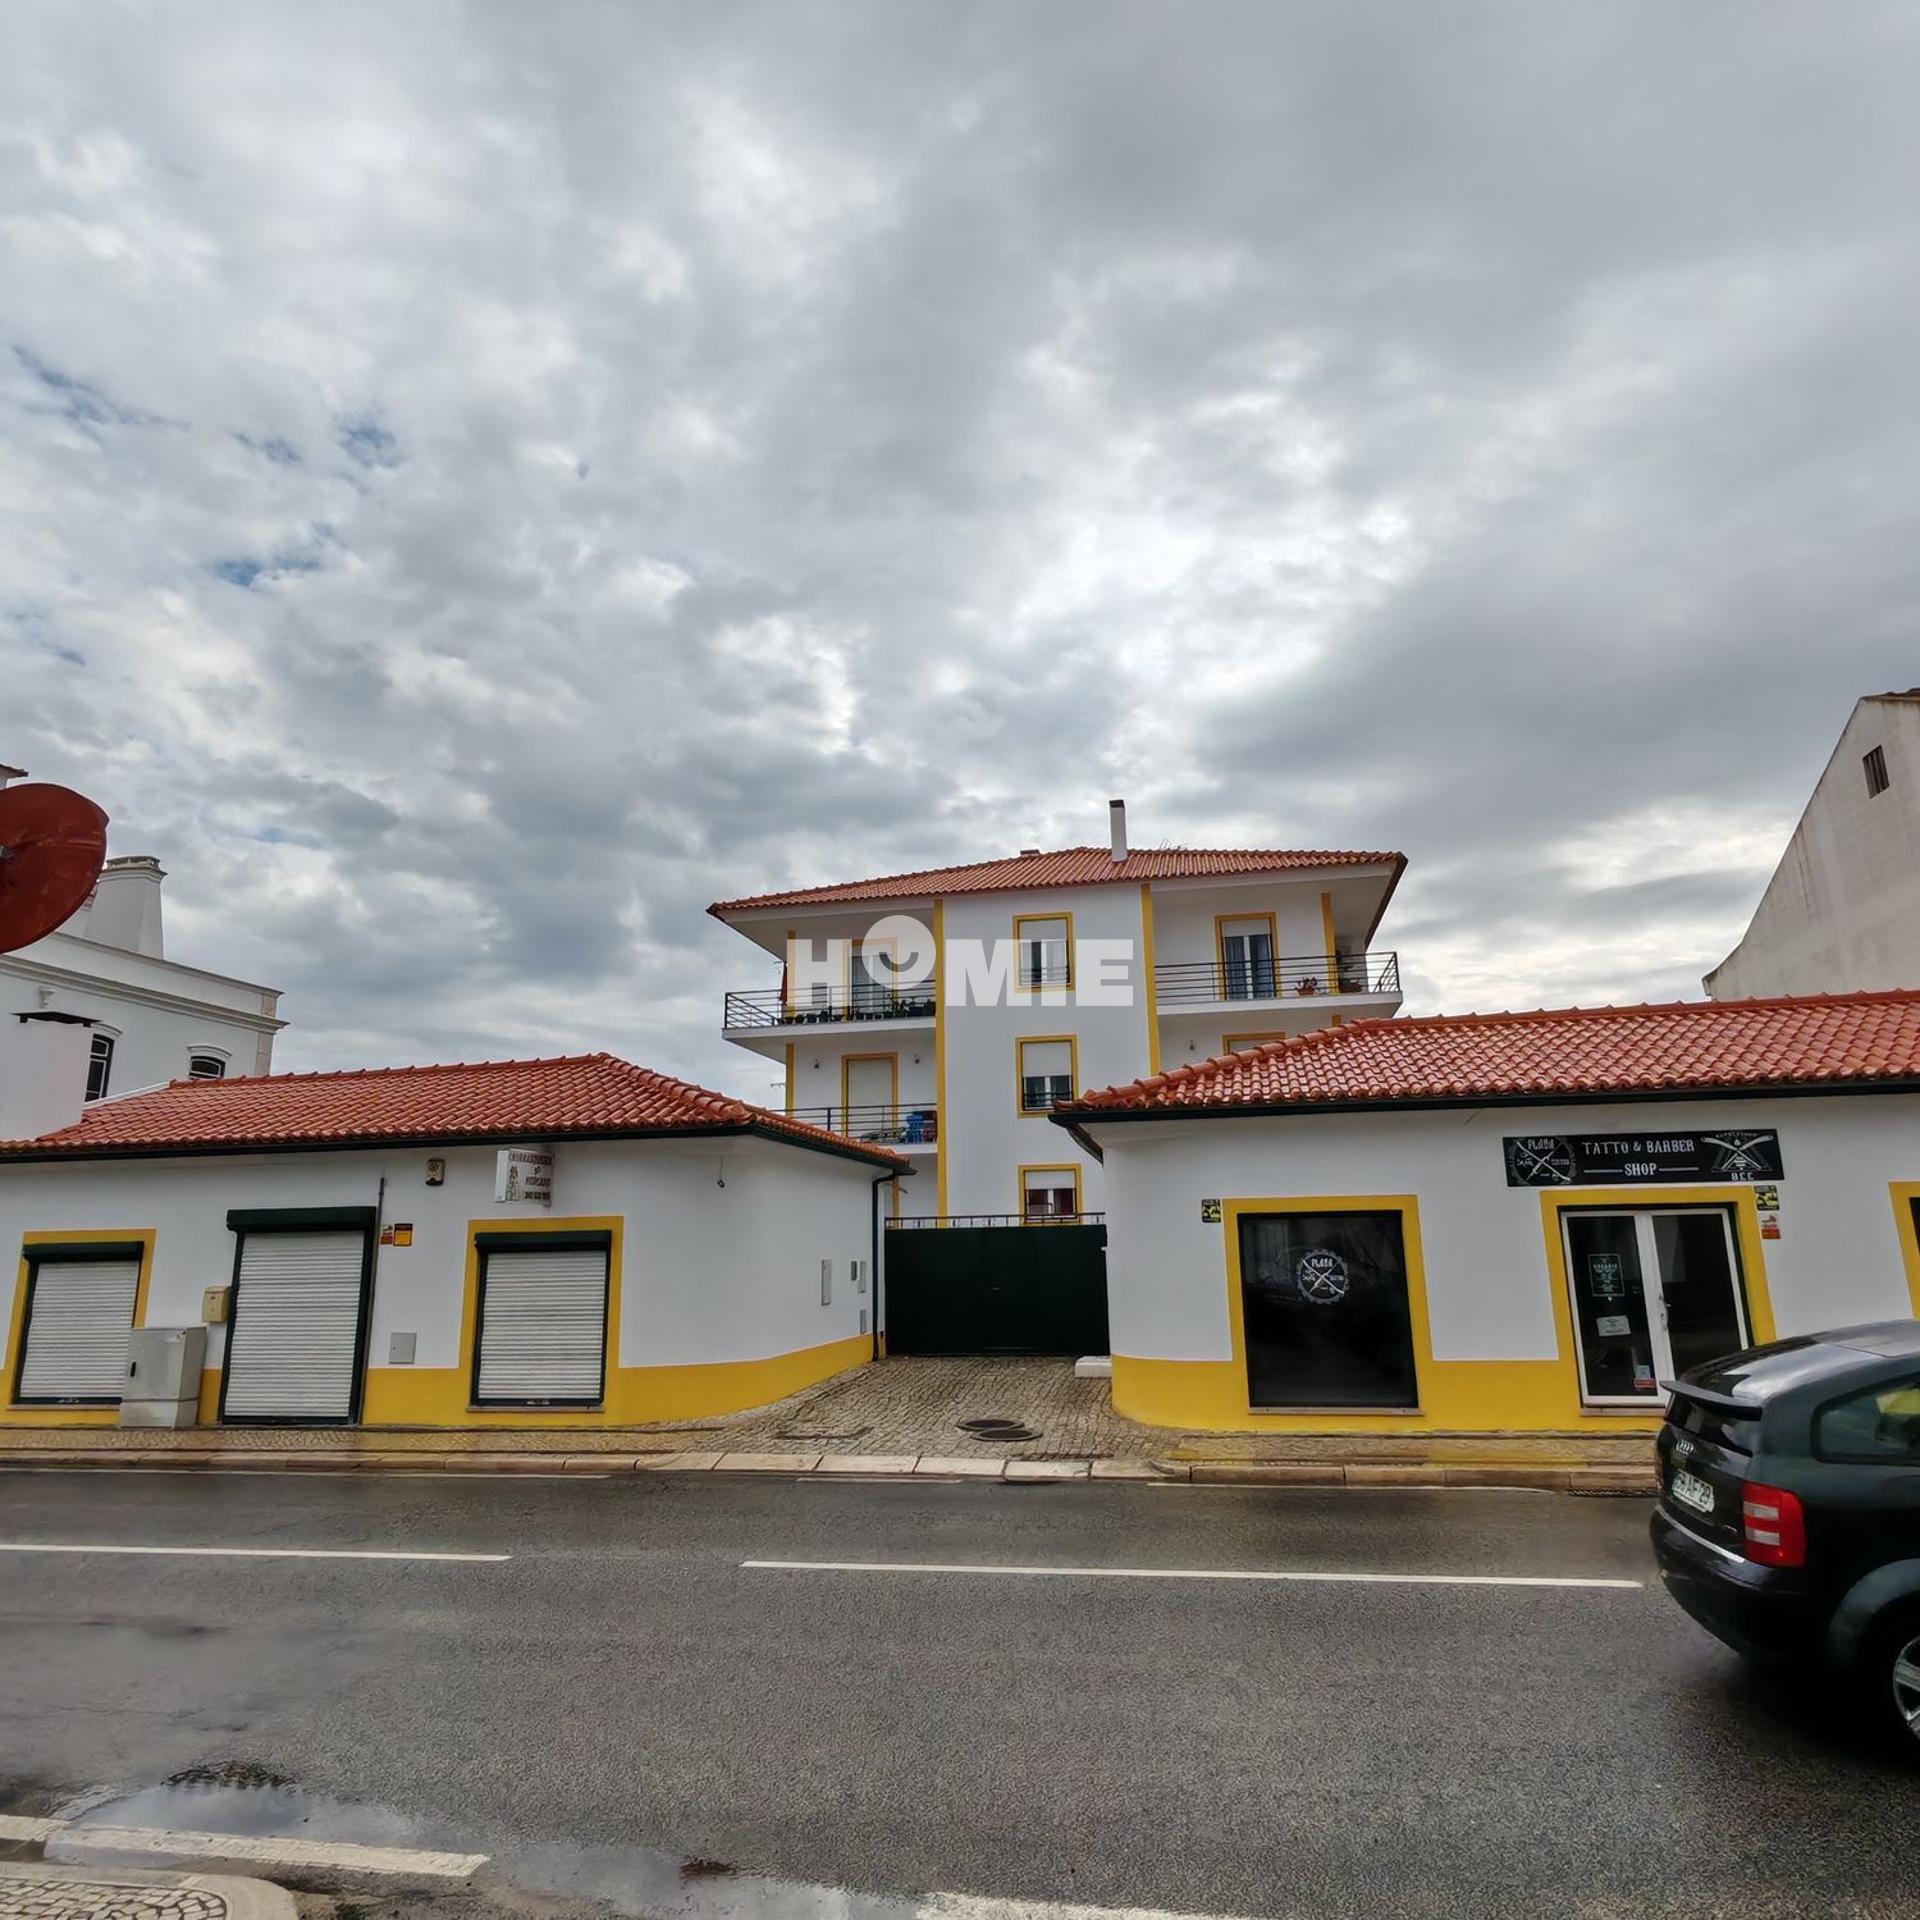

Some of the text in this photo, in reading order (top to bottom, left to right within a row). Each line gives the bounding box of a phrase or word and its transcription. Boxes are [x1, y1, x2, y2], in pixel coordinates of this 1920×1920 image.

[1581, 1139, 1696, 1155] TATTO & BARBER
[1624, 1162, 1657, 1176] SHOP
